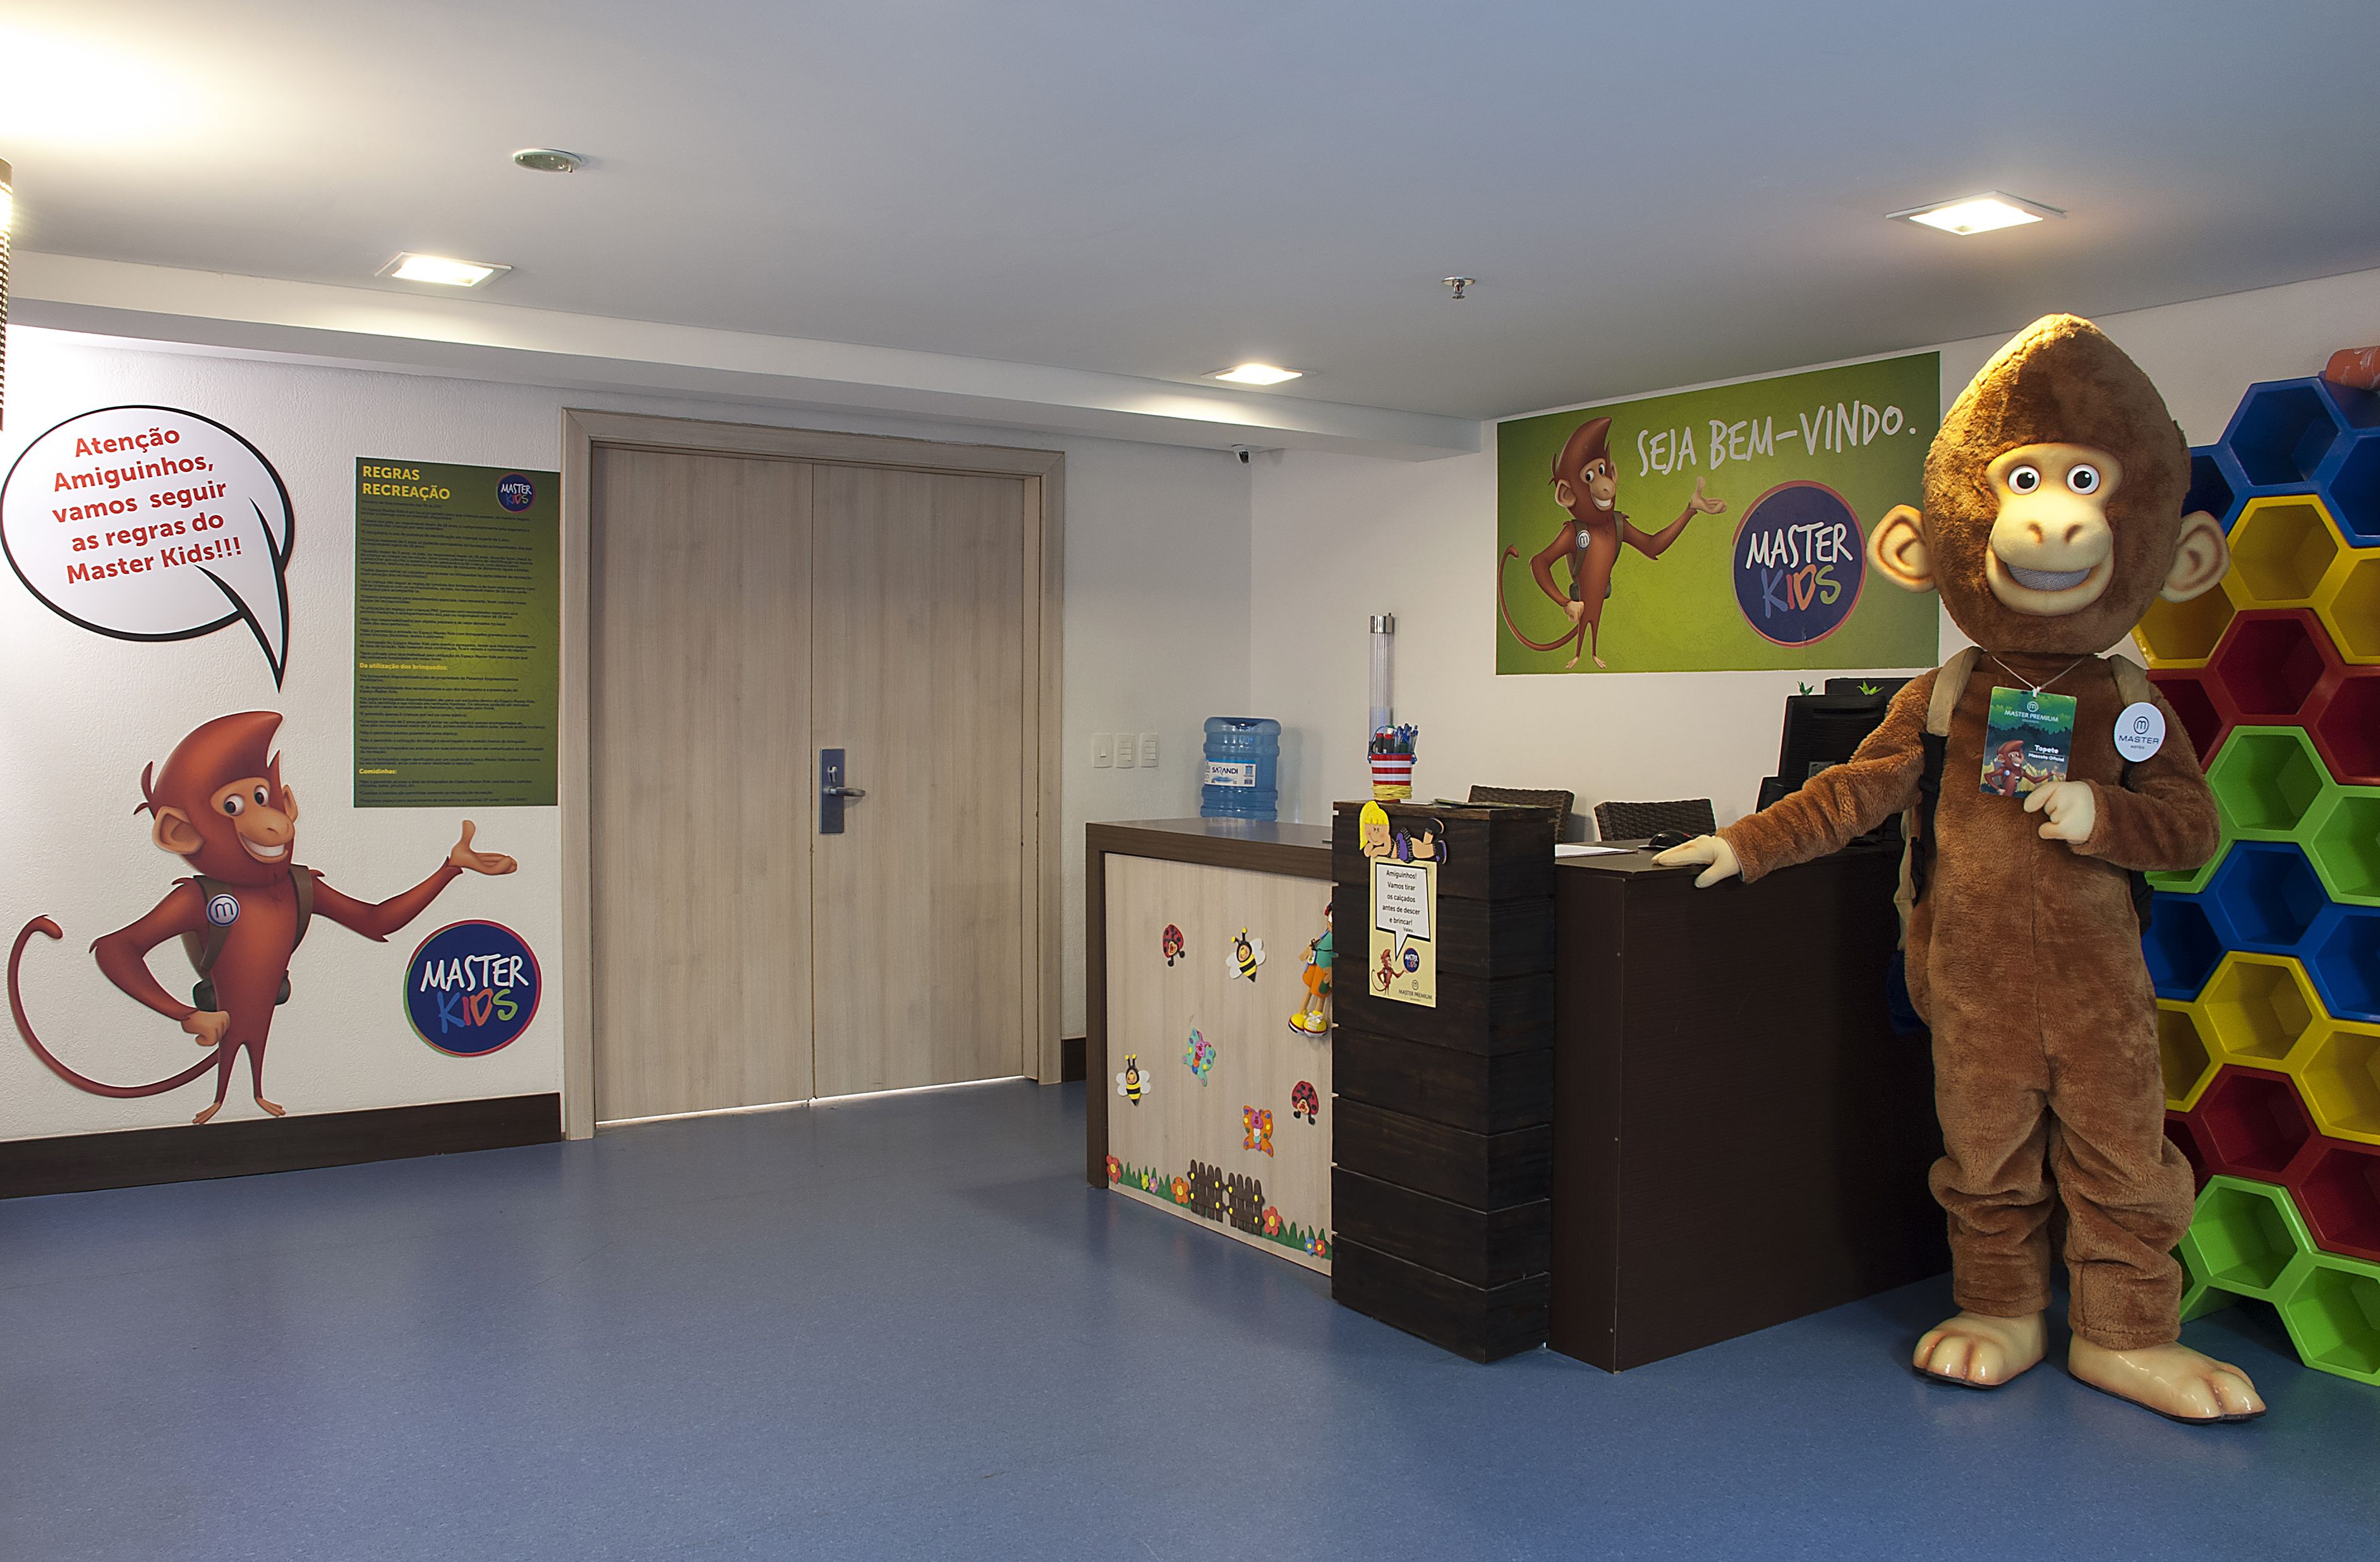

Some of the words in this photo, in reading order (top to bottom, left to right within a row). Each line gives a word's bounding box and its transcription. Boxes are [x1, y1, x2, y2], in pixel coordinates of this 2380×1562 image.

[75, 427, 180, 457] Atenção
[1637, 426, 1697, 478] SEJA
[1708, 400, 1918, 471] BEM-VINDO.
[54, 455, 214, 492] Amiguinhos,
[363, 465, 420, 481] REGRAS
[362, 483, 451, 501] RECREAÇÃO
[500, 483, 533, 496] MASTER
[52, 496, 138, 524] vamos
[149, 481, 227, 508] seguir
[505, 493, 529, 506] KIDS
[71, 534, 100, 553] as
[105, 519, 186, 548] regras
[191, 512, 224, 532] do
[1744, 520, 1854, 570] MASTER
[66, 552, 155, 585] Master
[160, 536, 242, 568] Kids!!!
[1760, 563, 1842, 618] KIDS
[2004, 709, 2029, 719] MASTER
[2029, 712, 2059, 723] PREMIUM
[2118, 735, 2160, 745] MASTER
[1212, 766, 1239, 776] SARANDI
[1386, 869, 1417, 880] Amiguinhos!
[1387, 881, 1404, 890] Vamos
[1404, 883, 1416, 891] tirar
[1394, 894, 1416, 903] calçados
[1403, 906, 1421, 915] descer
[1393, 916, 1413, 926] brincar!
[420, 952, 529, 994] MASTER
[1398, 988, 1414, 997] MASTER
[436, 988, 519, 1035] KIDS
